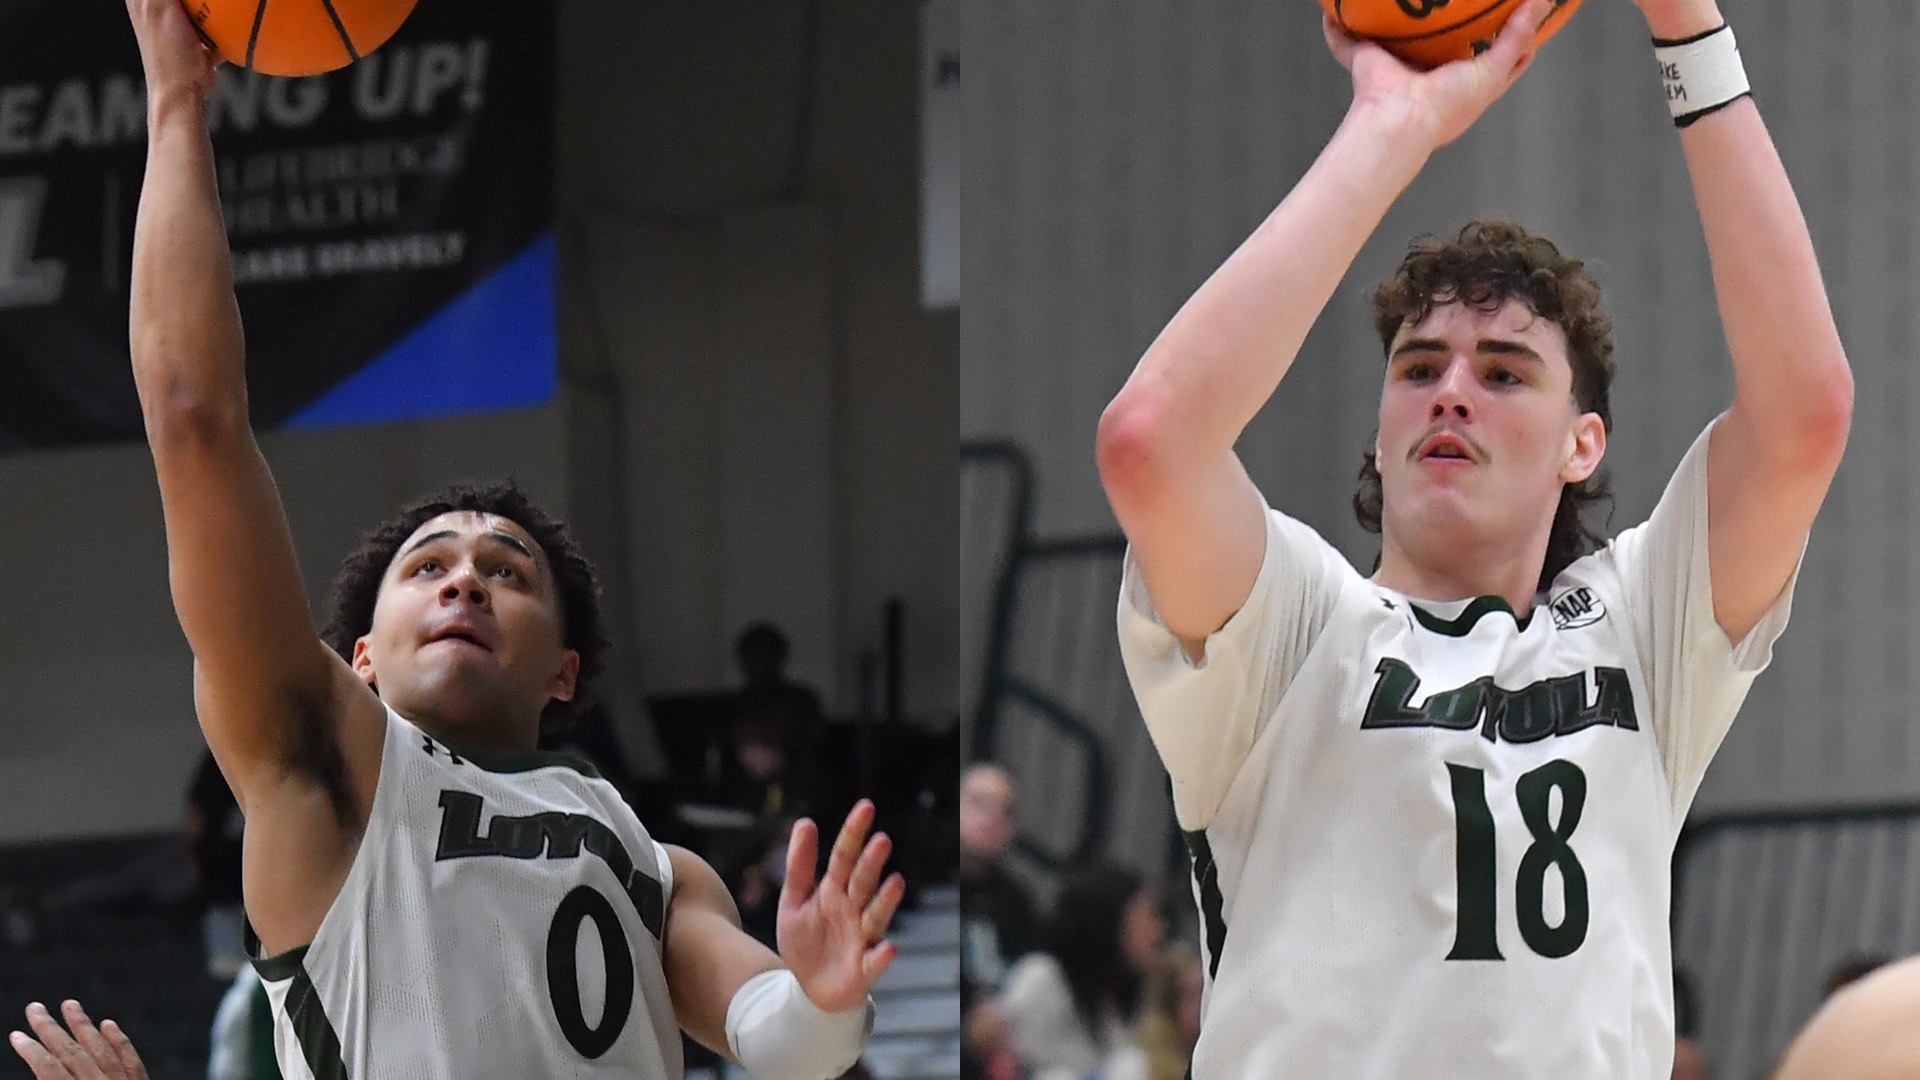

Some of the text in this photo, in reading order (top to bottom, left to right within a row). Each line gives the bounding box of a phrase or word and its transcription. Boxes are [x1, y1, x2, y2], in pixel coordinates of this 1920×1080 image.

[0, 40, 488, 153] EAMNG UP!
[1555, 588, 1592, 622] NAP
[1360, 657, 1639, 744] LOYOLA
[1444, 758, 1589, 961] 18
[546, 885, 634, 1059] 0
